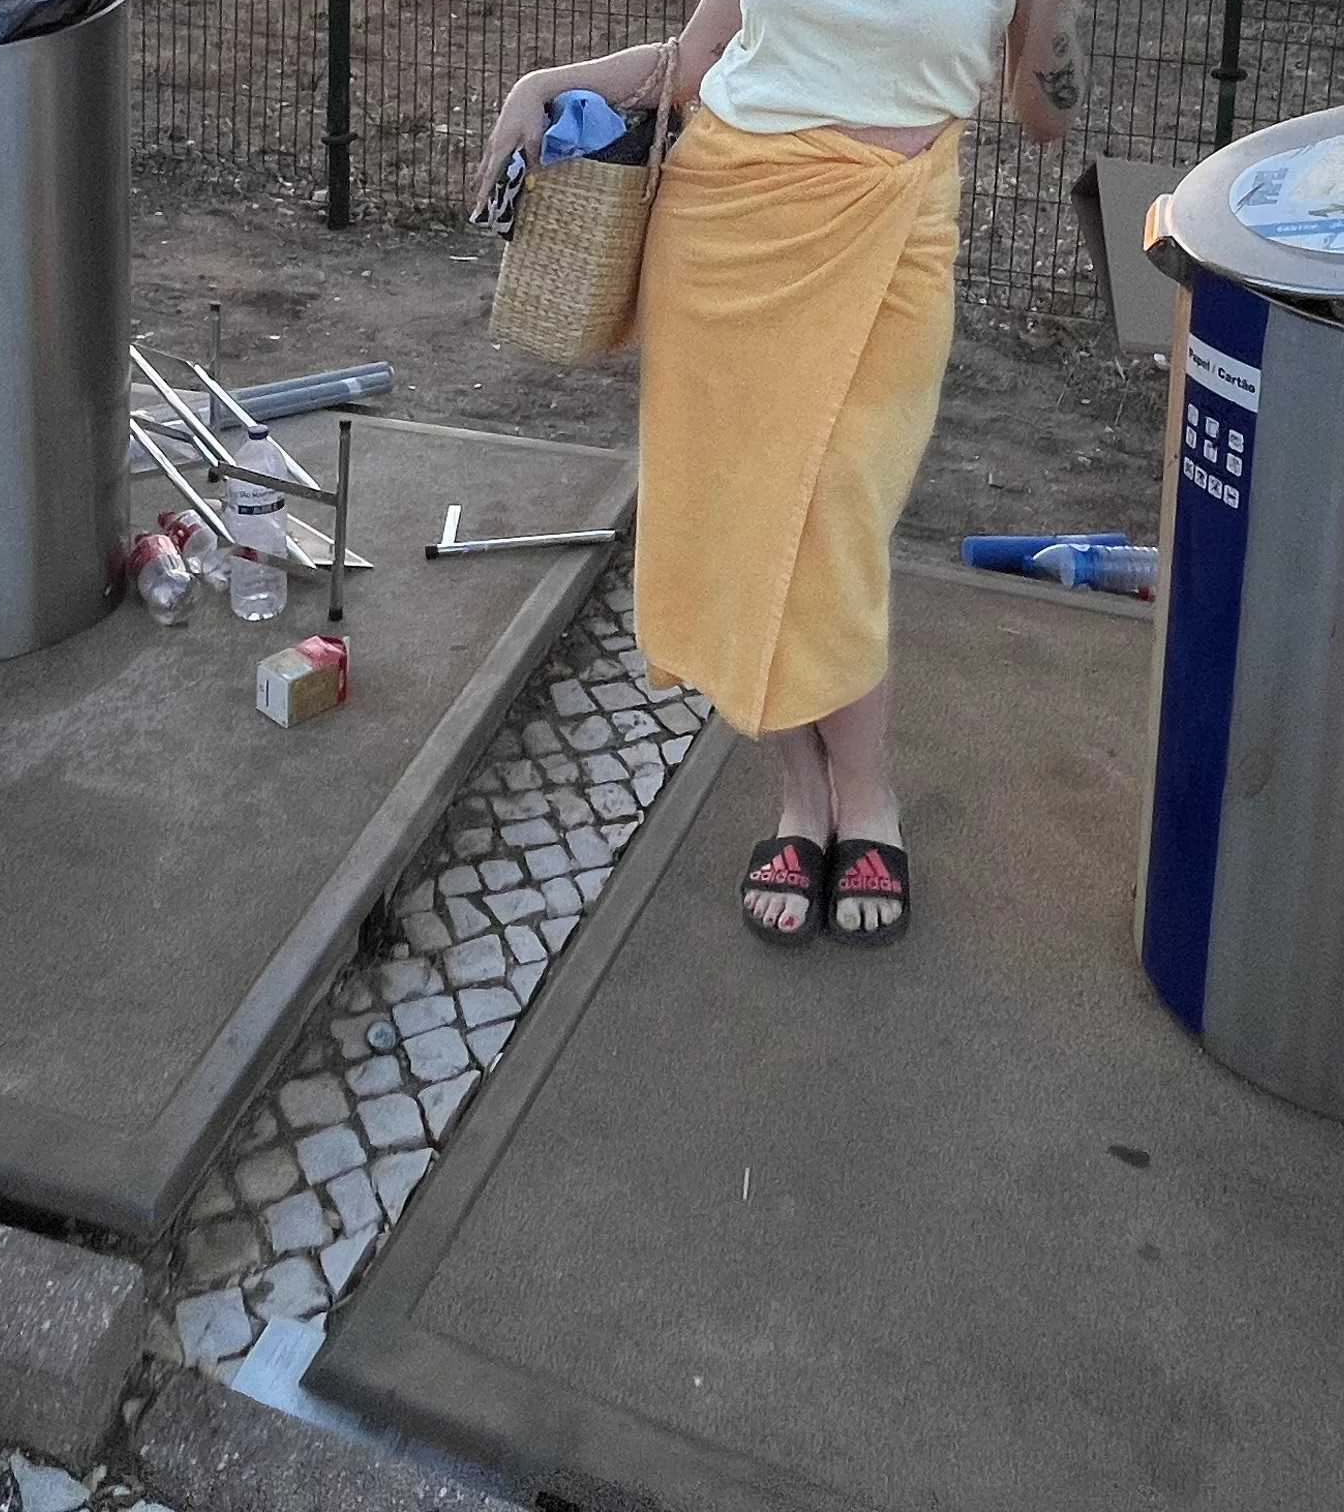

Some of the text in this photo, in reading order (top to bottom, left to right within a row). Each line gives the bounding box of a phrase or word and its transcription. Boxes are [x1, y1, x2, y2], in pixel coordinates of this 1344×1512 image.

[1188, 347, 1211, 372] Papel
[1217, 367, 1256, 394] Cartão
[749, 868, 811, 888] adidas
[838, 875, 903, 894] adidas
